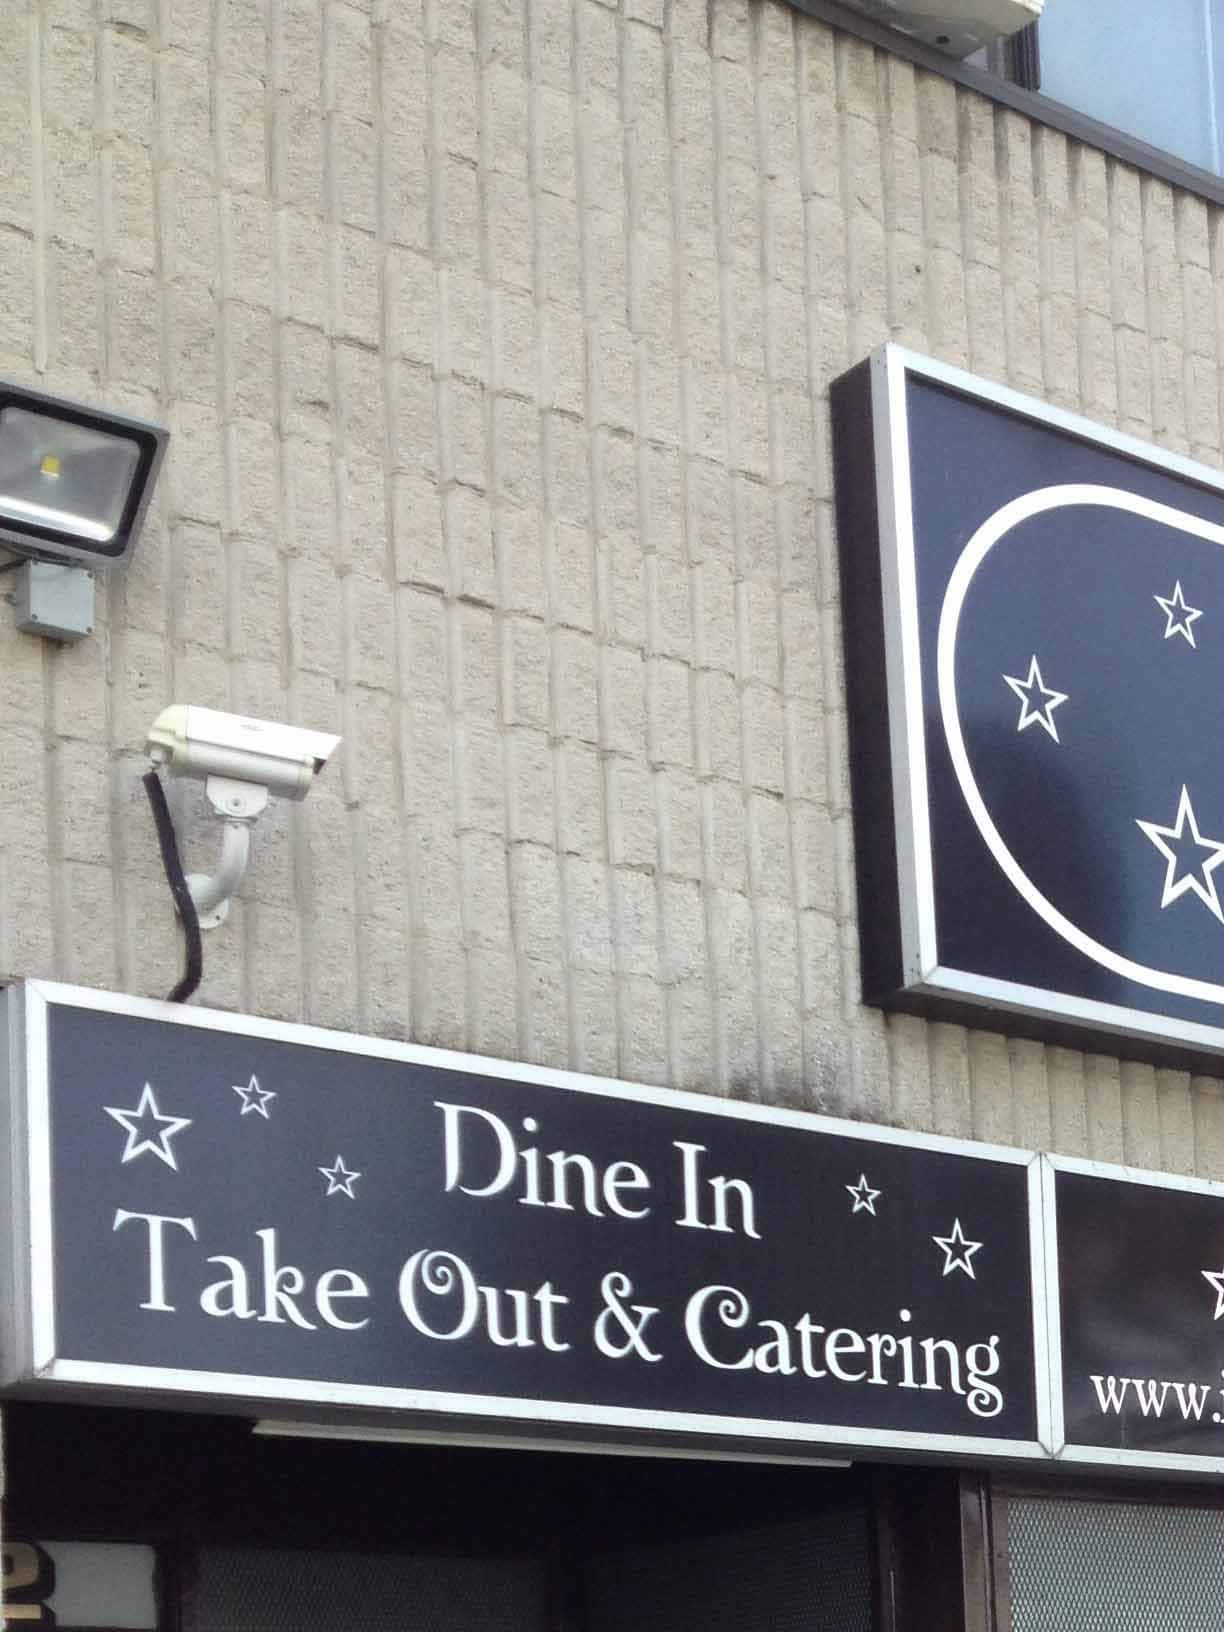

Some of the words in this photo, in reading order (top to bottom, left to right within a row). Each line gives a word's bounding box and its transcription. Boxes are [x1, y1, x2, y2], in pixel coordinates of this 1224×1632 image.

[434, 1101, 650, 1220] Dine
[672, 1141, 762, 1240] In
[112, 1207, 371, 1332] Take
[398, 1247, 571, 1353] Out
[594, 1271, 664, 1363] &
[684, 1285, 1004, 1418] Catering
